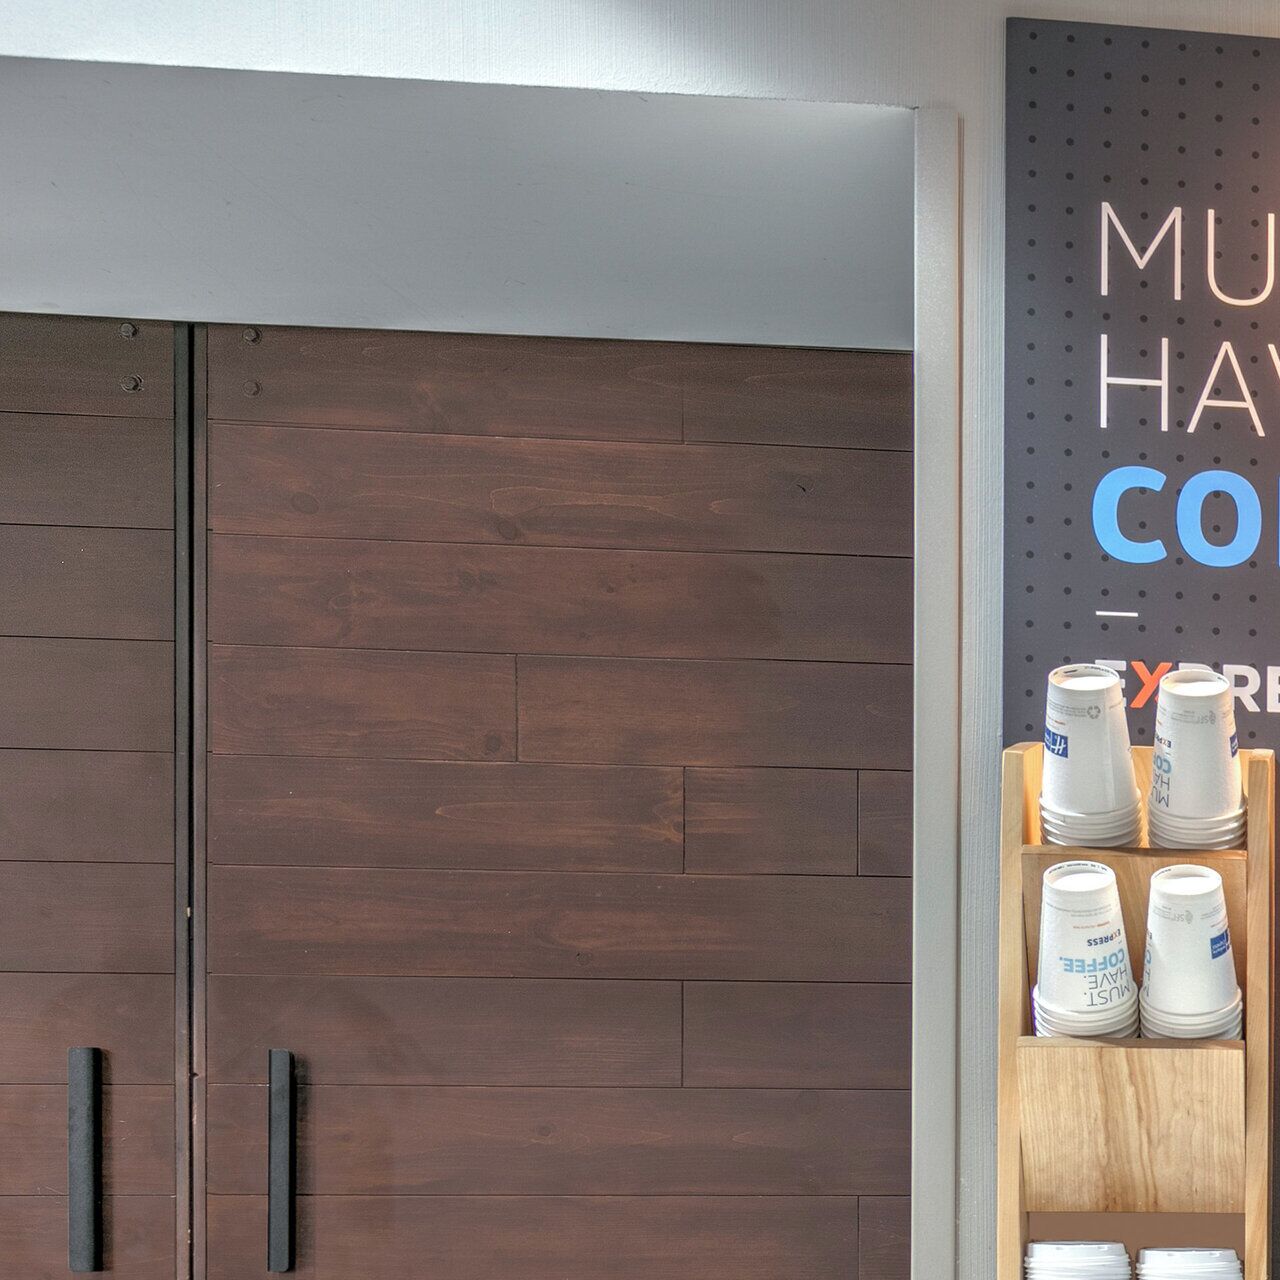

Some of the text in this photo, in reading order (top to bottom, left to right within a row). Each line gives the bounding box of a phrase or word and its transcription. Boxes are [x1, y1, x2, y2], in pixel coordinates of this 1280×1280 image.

[1087, 928, 1121, 947] EXPRESS
[1059, 948, 1125, 973] COFFEE.
[1084, 963, 1127, 990] HAVE.
[1084, 982, 1131, 1007] MUST.
